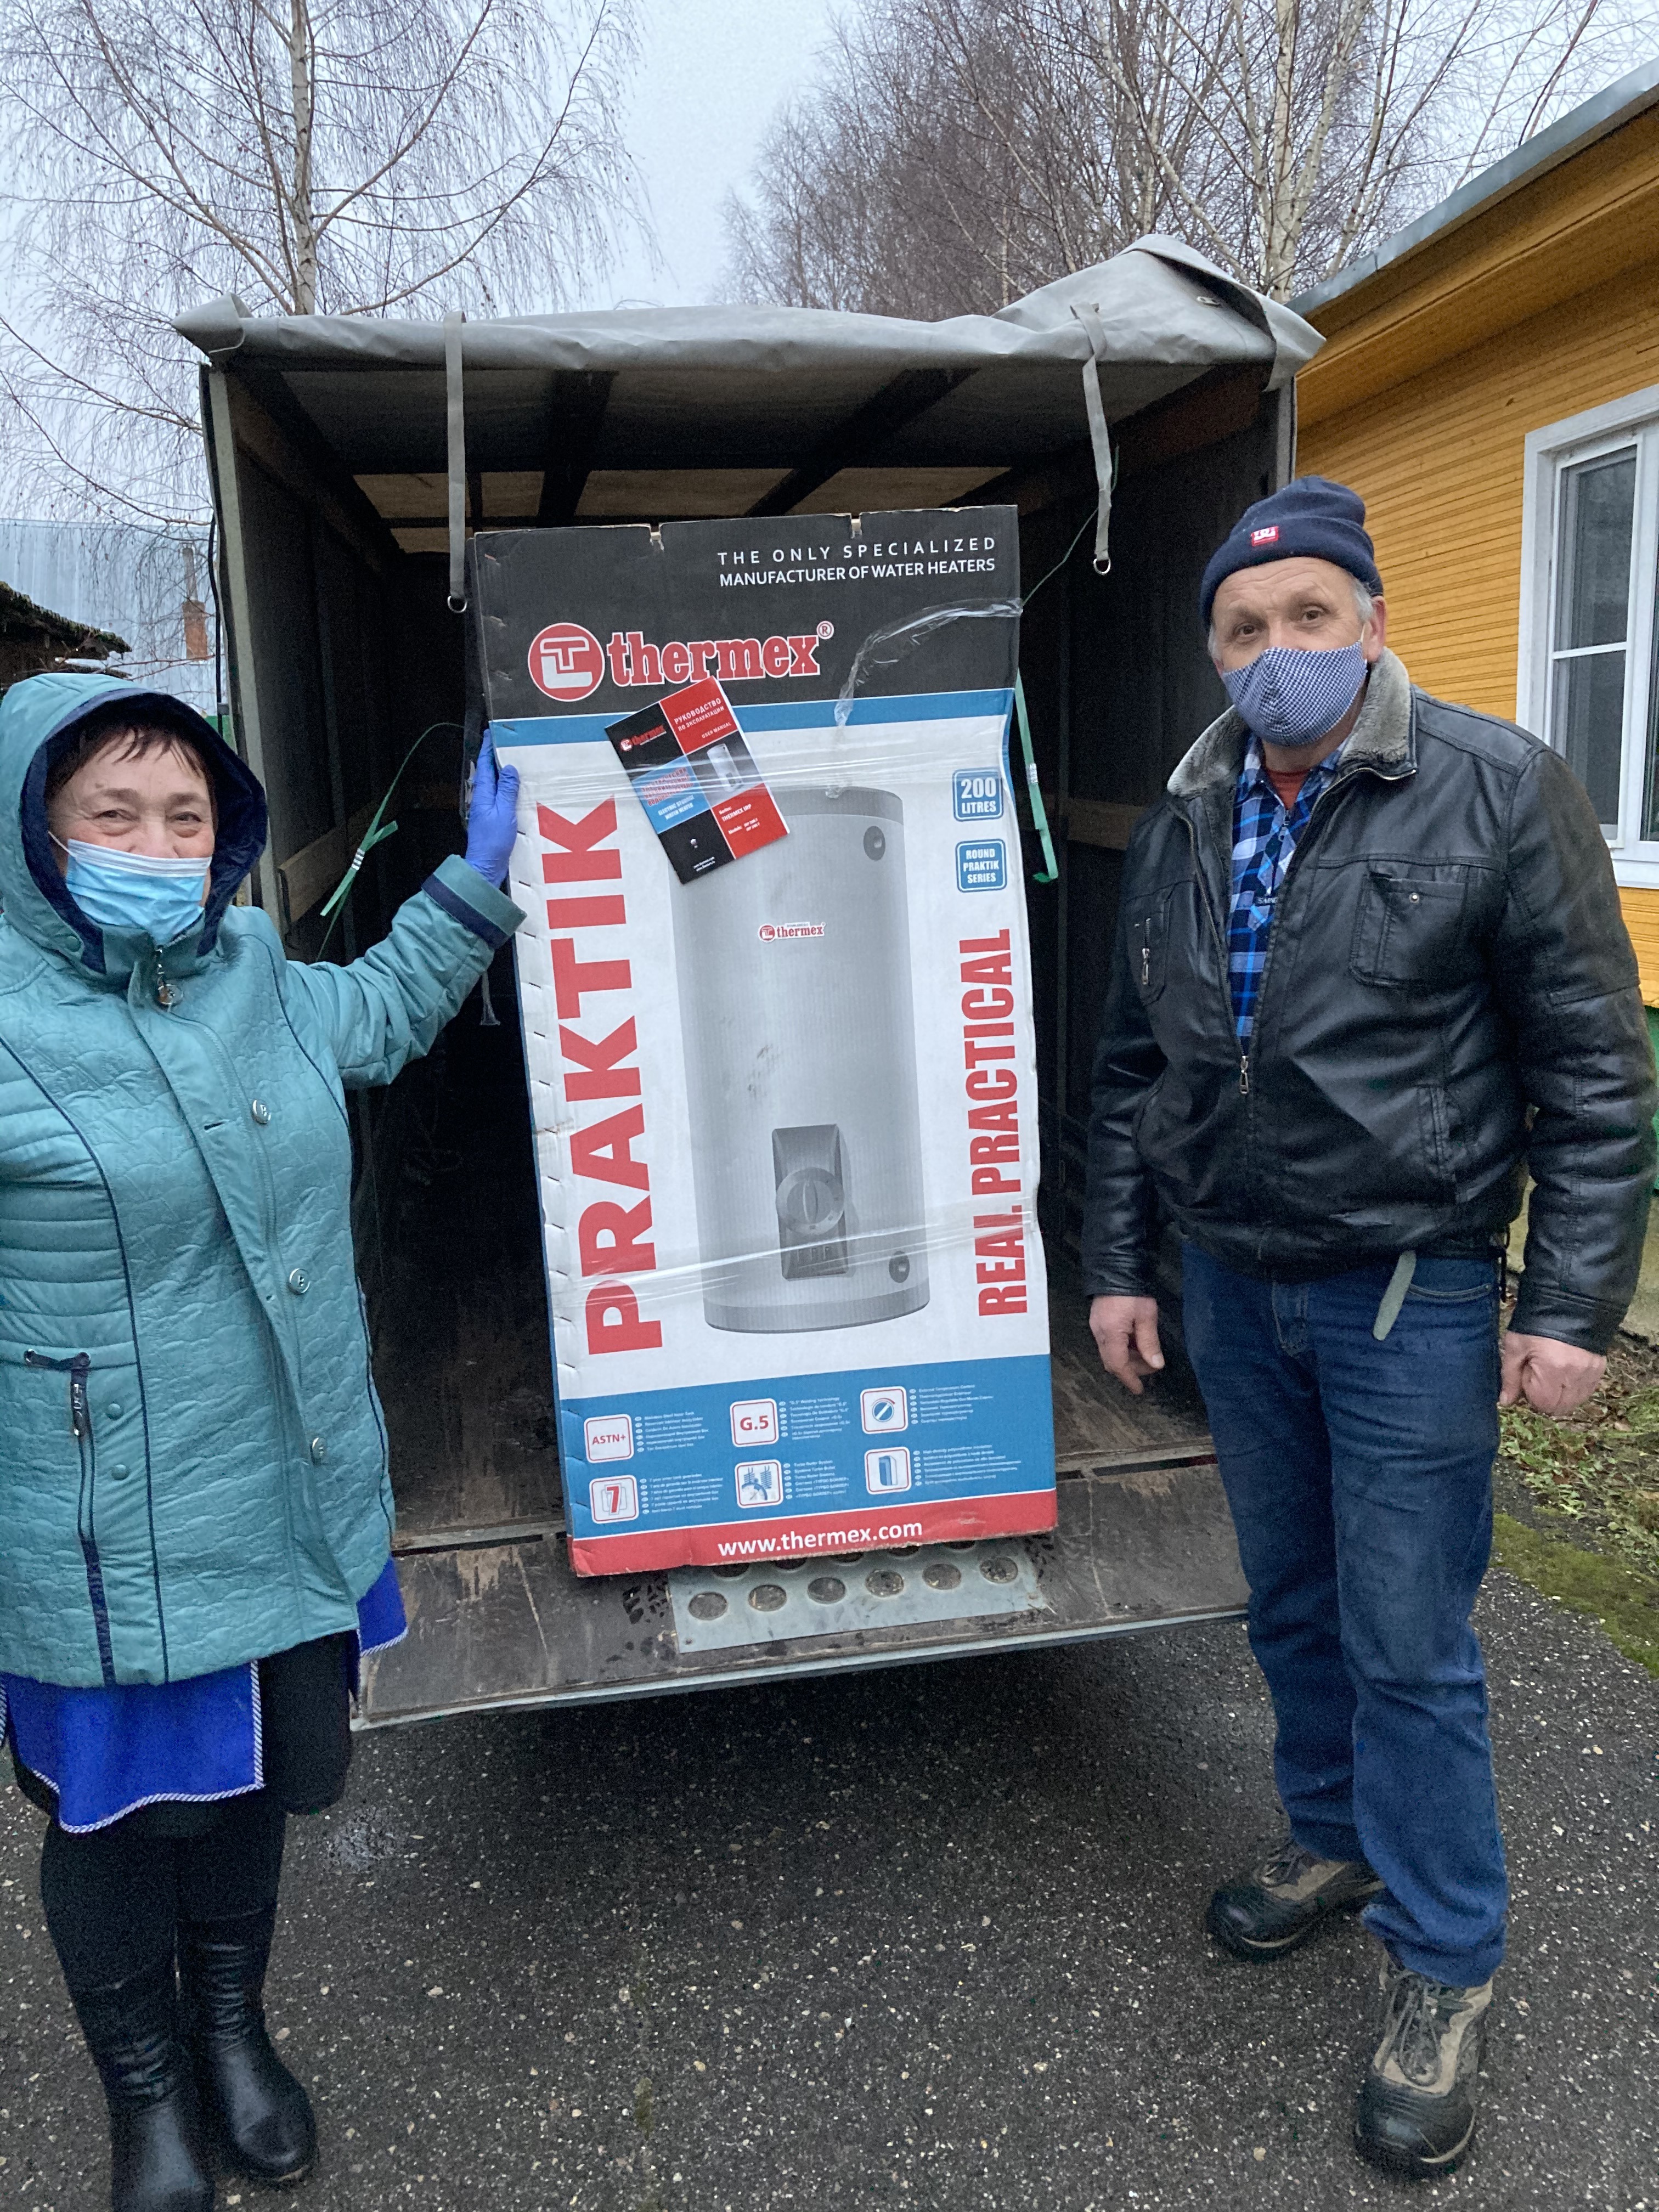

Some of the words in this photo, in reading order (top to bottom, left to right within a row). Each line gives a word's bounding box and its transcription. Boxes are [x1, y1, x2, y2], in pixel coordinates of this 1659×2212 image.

[718, 551, 760, 566] THE
[773, 546, 830, 562] ONLY
[843, 537, 995, 558] SPECIALIZED
[719, 567, 846, 586] MANUFACTURER
[849, 566, 869, 579] OF
[871, 562, 924, 578] WATER
[928, 558, 995, 574] HEATERS
[674, 697, 721, 725] РУКОВОДСТВО
[686, 706, 725, 728] ЭКСПЛУАТАЦИИ
[702, 730, 714, 738] USER
[713, 721, 732, 733] MANUAL
[961, 776, 997, 799] 200
[721, 807, 744, 822] THERMEX
[962, 800, 997, 814] LITRES
[966, 848, 996, 860] ROUND
[963, 860, 1000, 872] PRAKTIK
[967, 872, 996, 884] SERIES
[777, 926, 823, 938] thermex
[959, 928, 1022, 1195] PRACTICAL
[536, 794, 663, 1355] PRAKTIK
[973, 1205, 1028, 1317] REAL
[740, 1415, 769, 1431] G.5
[592, 1434, 627, 1445] ASTN+
[606, 1485, 620, 1513] 7
[718, 1522, 923, 1557] www.thermex.com
